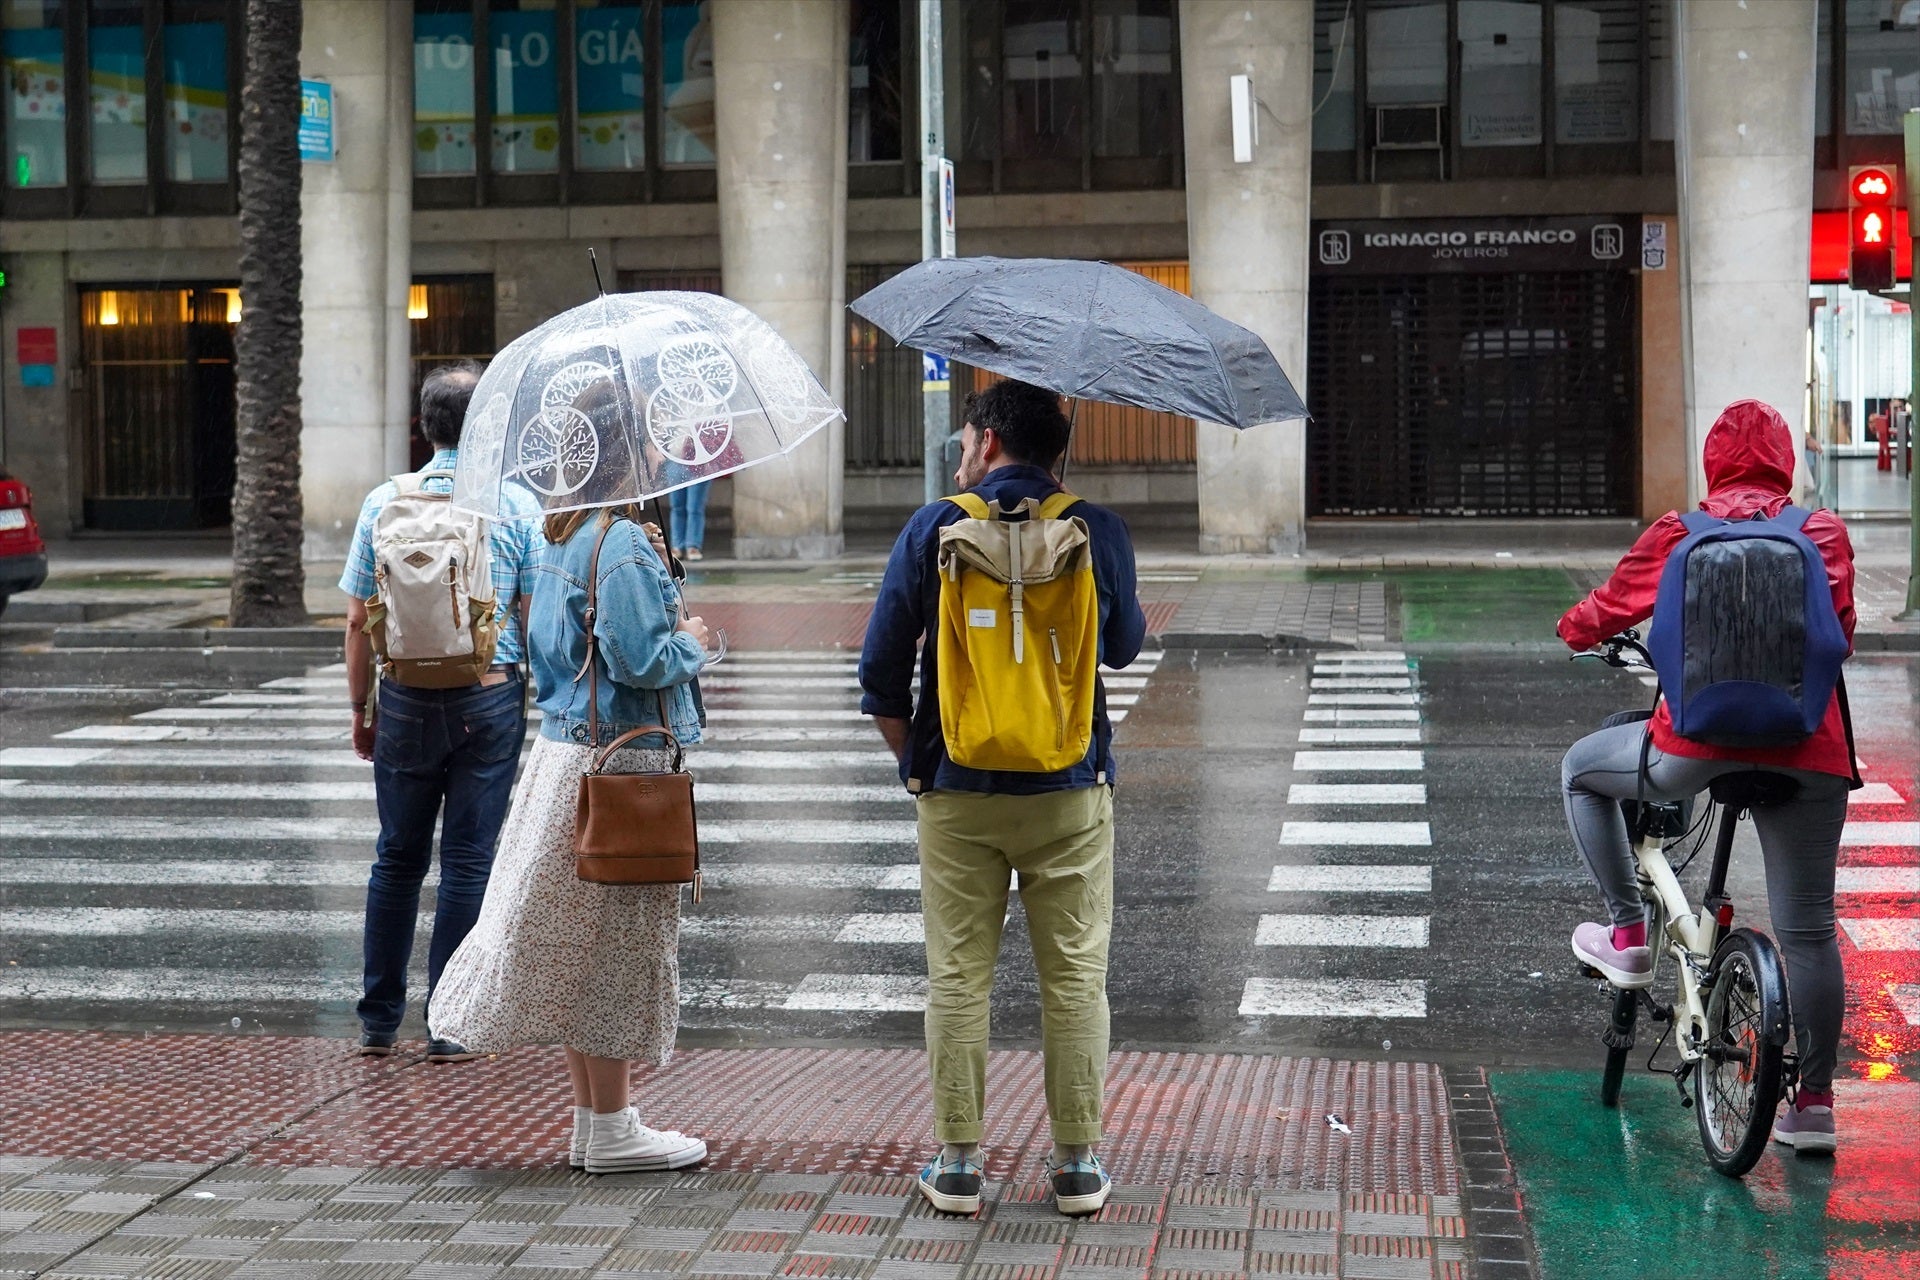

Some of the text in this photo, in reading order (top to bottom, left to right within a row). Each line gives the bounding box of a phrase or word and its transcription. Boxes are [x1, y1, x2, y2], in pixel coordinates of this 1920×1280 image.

[579, 20, 644, 66] GÍA
[1364, 229, 1576, 247] IGNACIO FRANCO
[1431, 247, 1509, 259] JOYEROS
